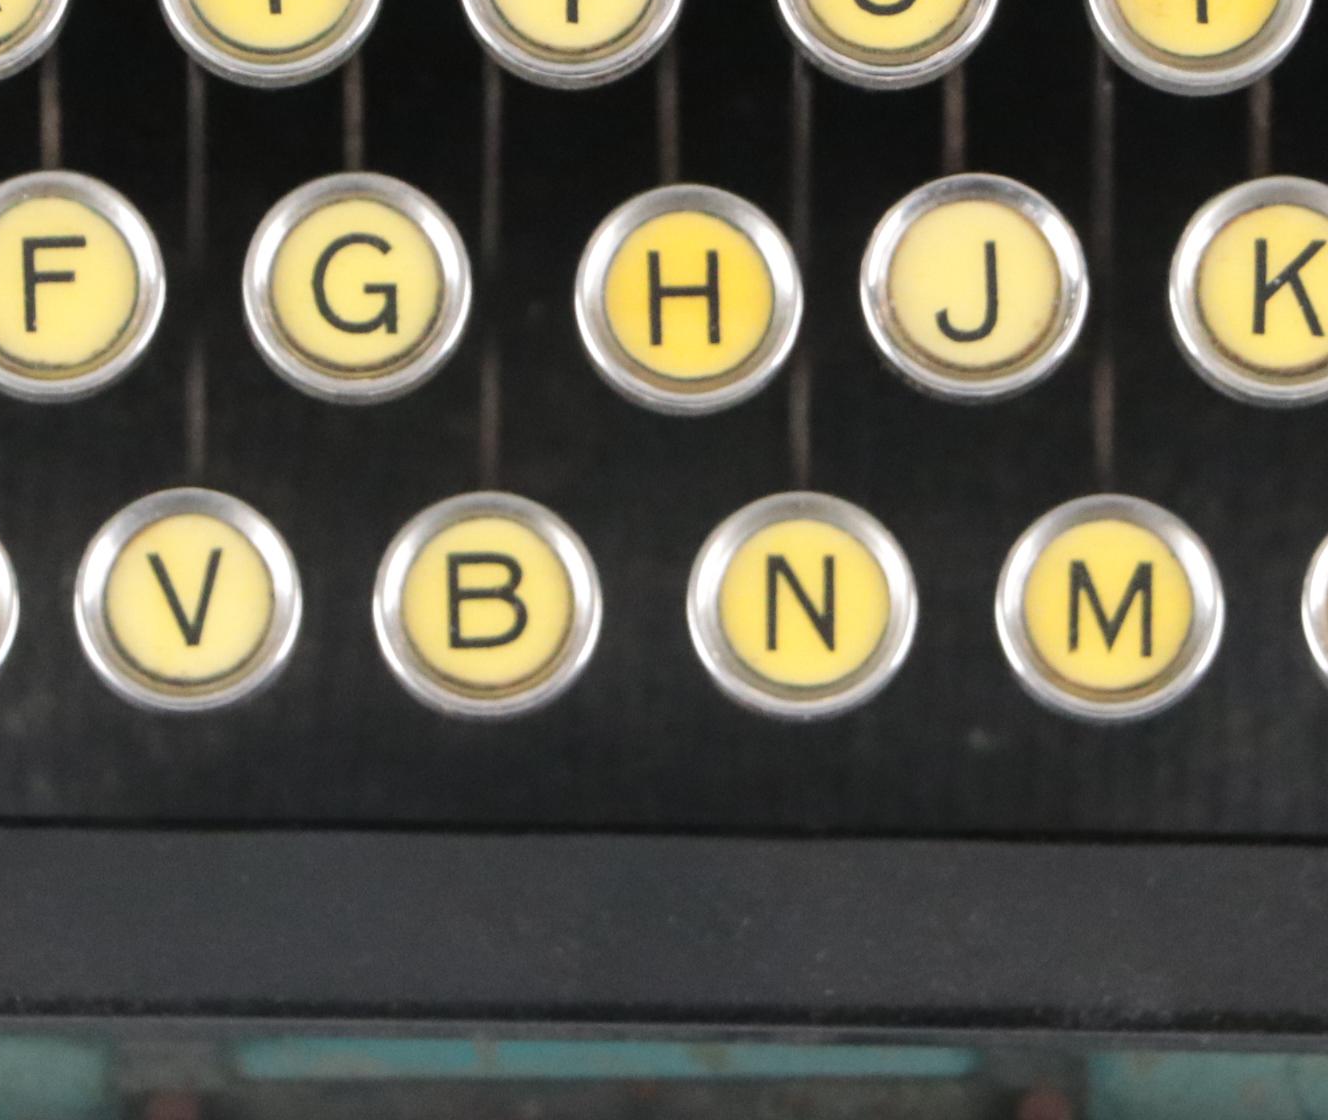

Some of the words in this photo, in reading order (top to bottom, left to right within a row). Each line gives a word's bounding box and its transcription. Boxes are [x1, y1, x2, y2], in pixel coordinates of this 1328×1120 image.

[22, 236, 86, 332] F
[312, 233, 398, 334] G
[648, 250, 721, 346] H
[936, 242, 999, 343] J
[1253, 239, 1326, 337] K
[149, 550, 221, 646] V
[448, 553, 528, 649] B
[767, 555, 835, 651] N
[1069, 561, 1153, 657] M
